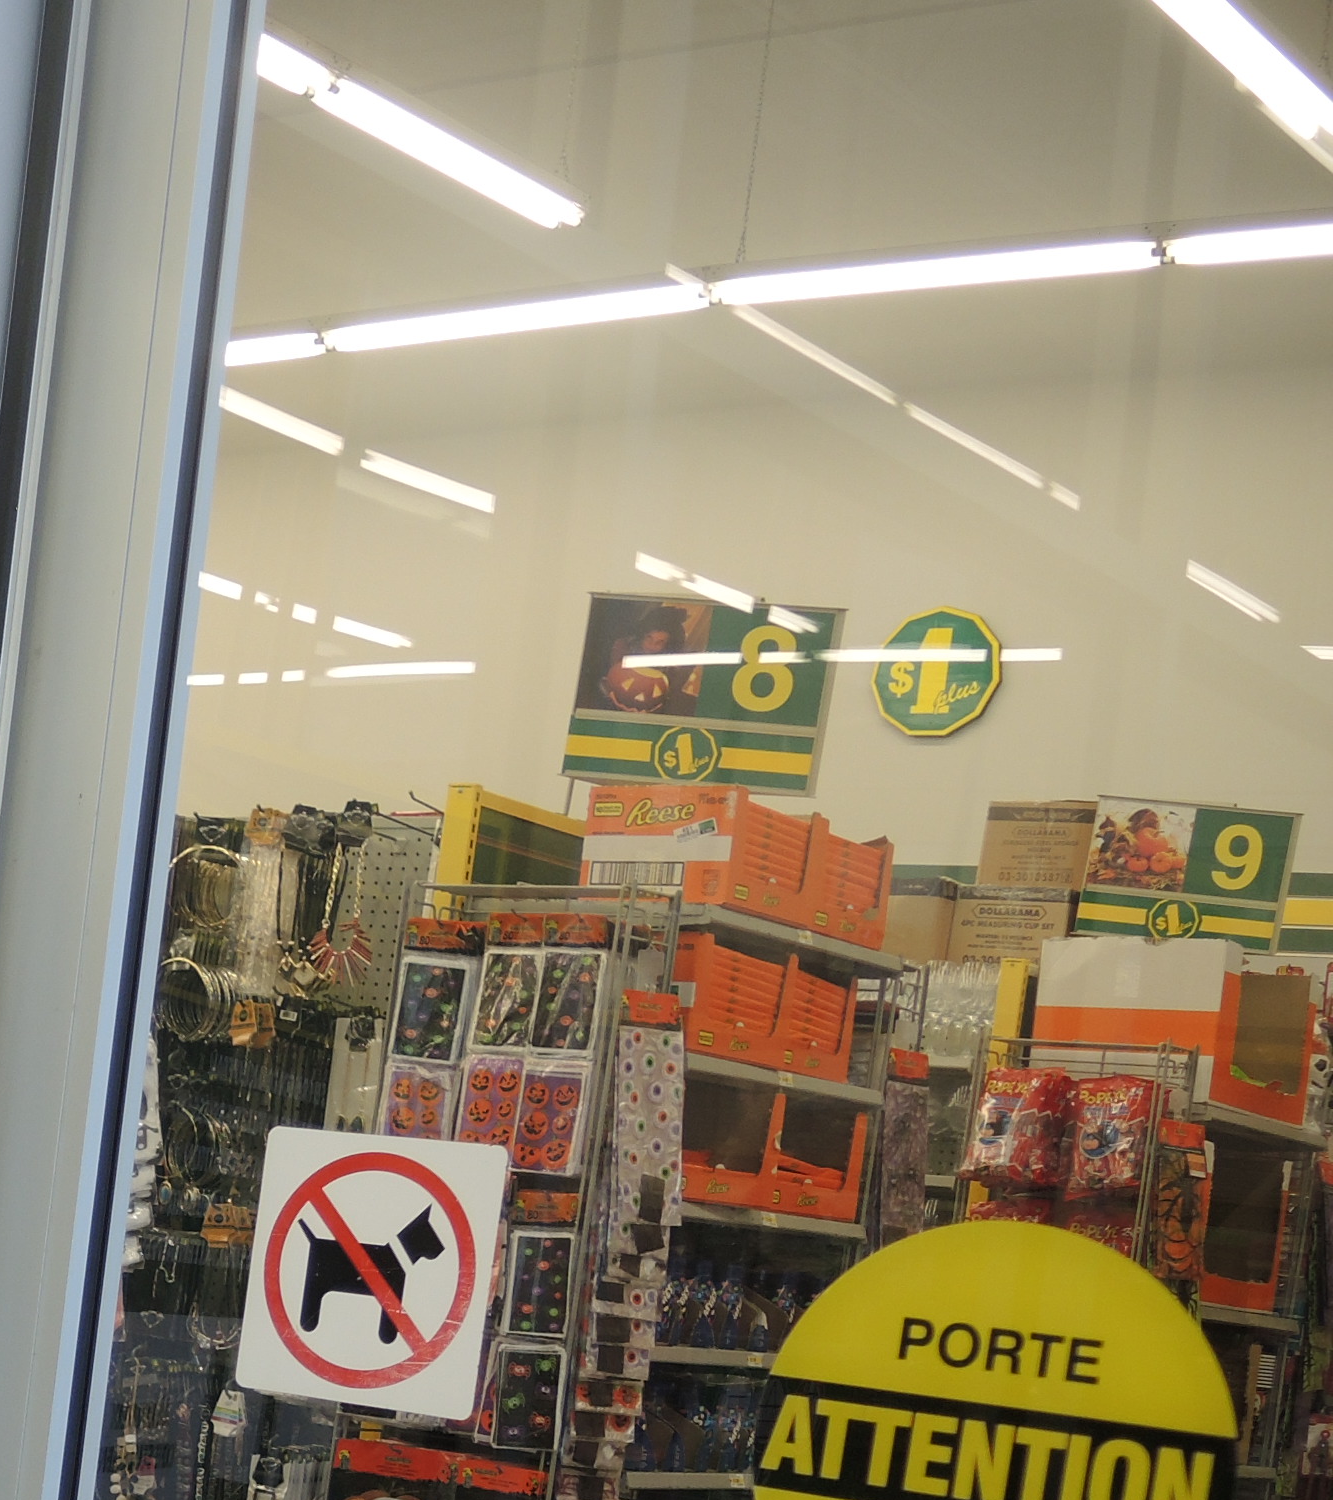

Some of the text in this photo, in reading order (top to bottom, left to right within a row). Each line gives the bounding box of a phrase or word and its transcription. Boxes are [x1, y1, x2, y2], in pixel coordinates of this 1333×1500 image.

[732, 625, 797, 713] 8
[887, 626, 981, 716] $1 plus
[626, 798, 696, 827] Reese
[1211, 824, 1264, 892] 9
[979, 906, 1040, 917] DOLLARAMA
[897, 1317, 1105, 1385] PORTE
